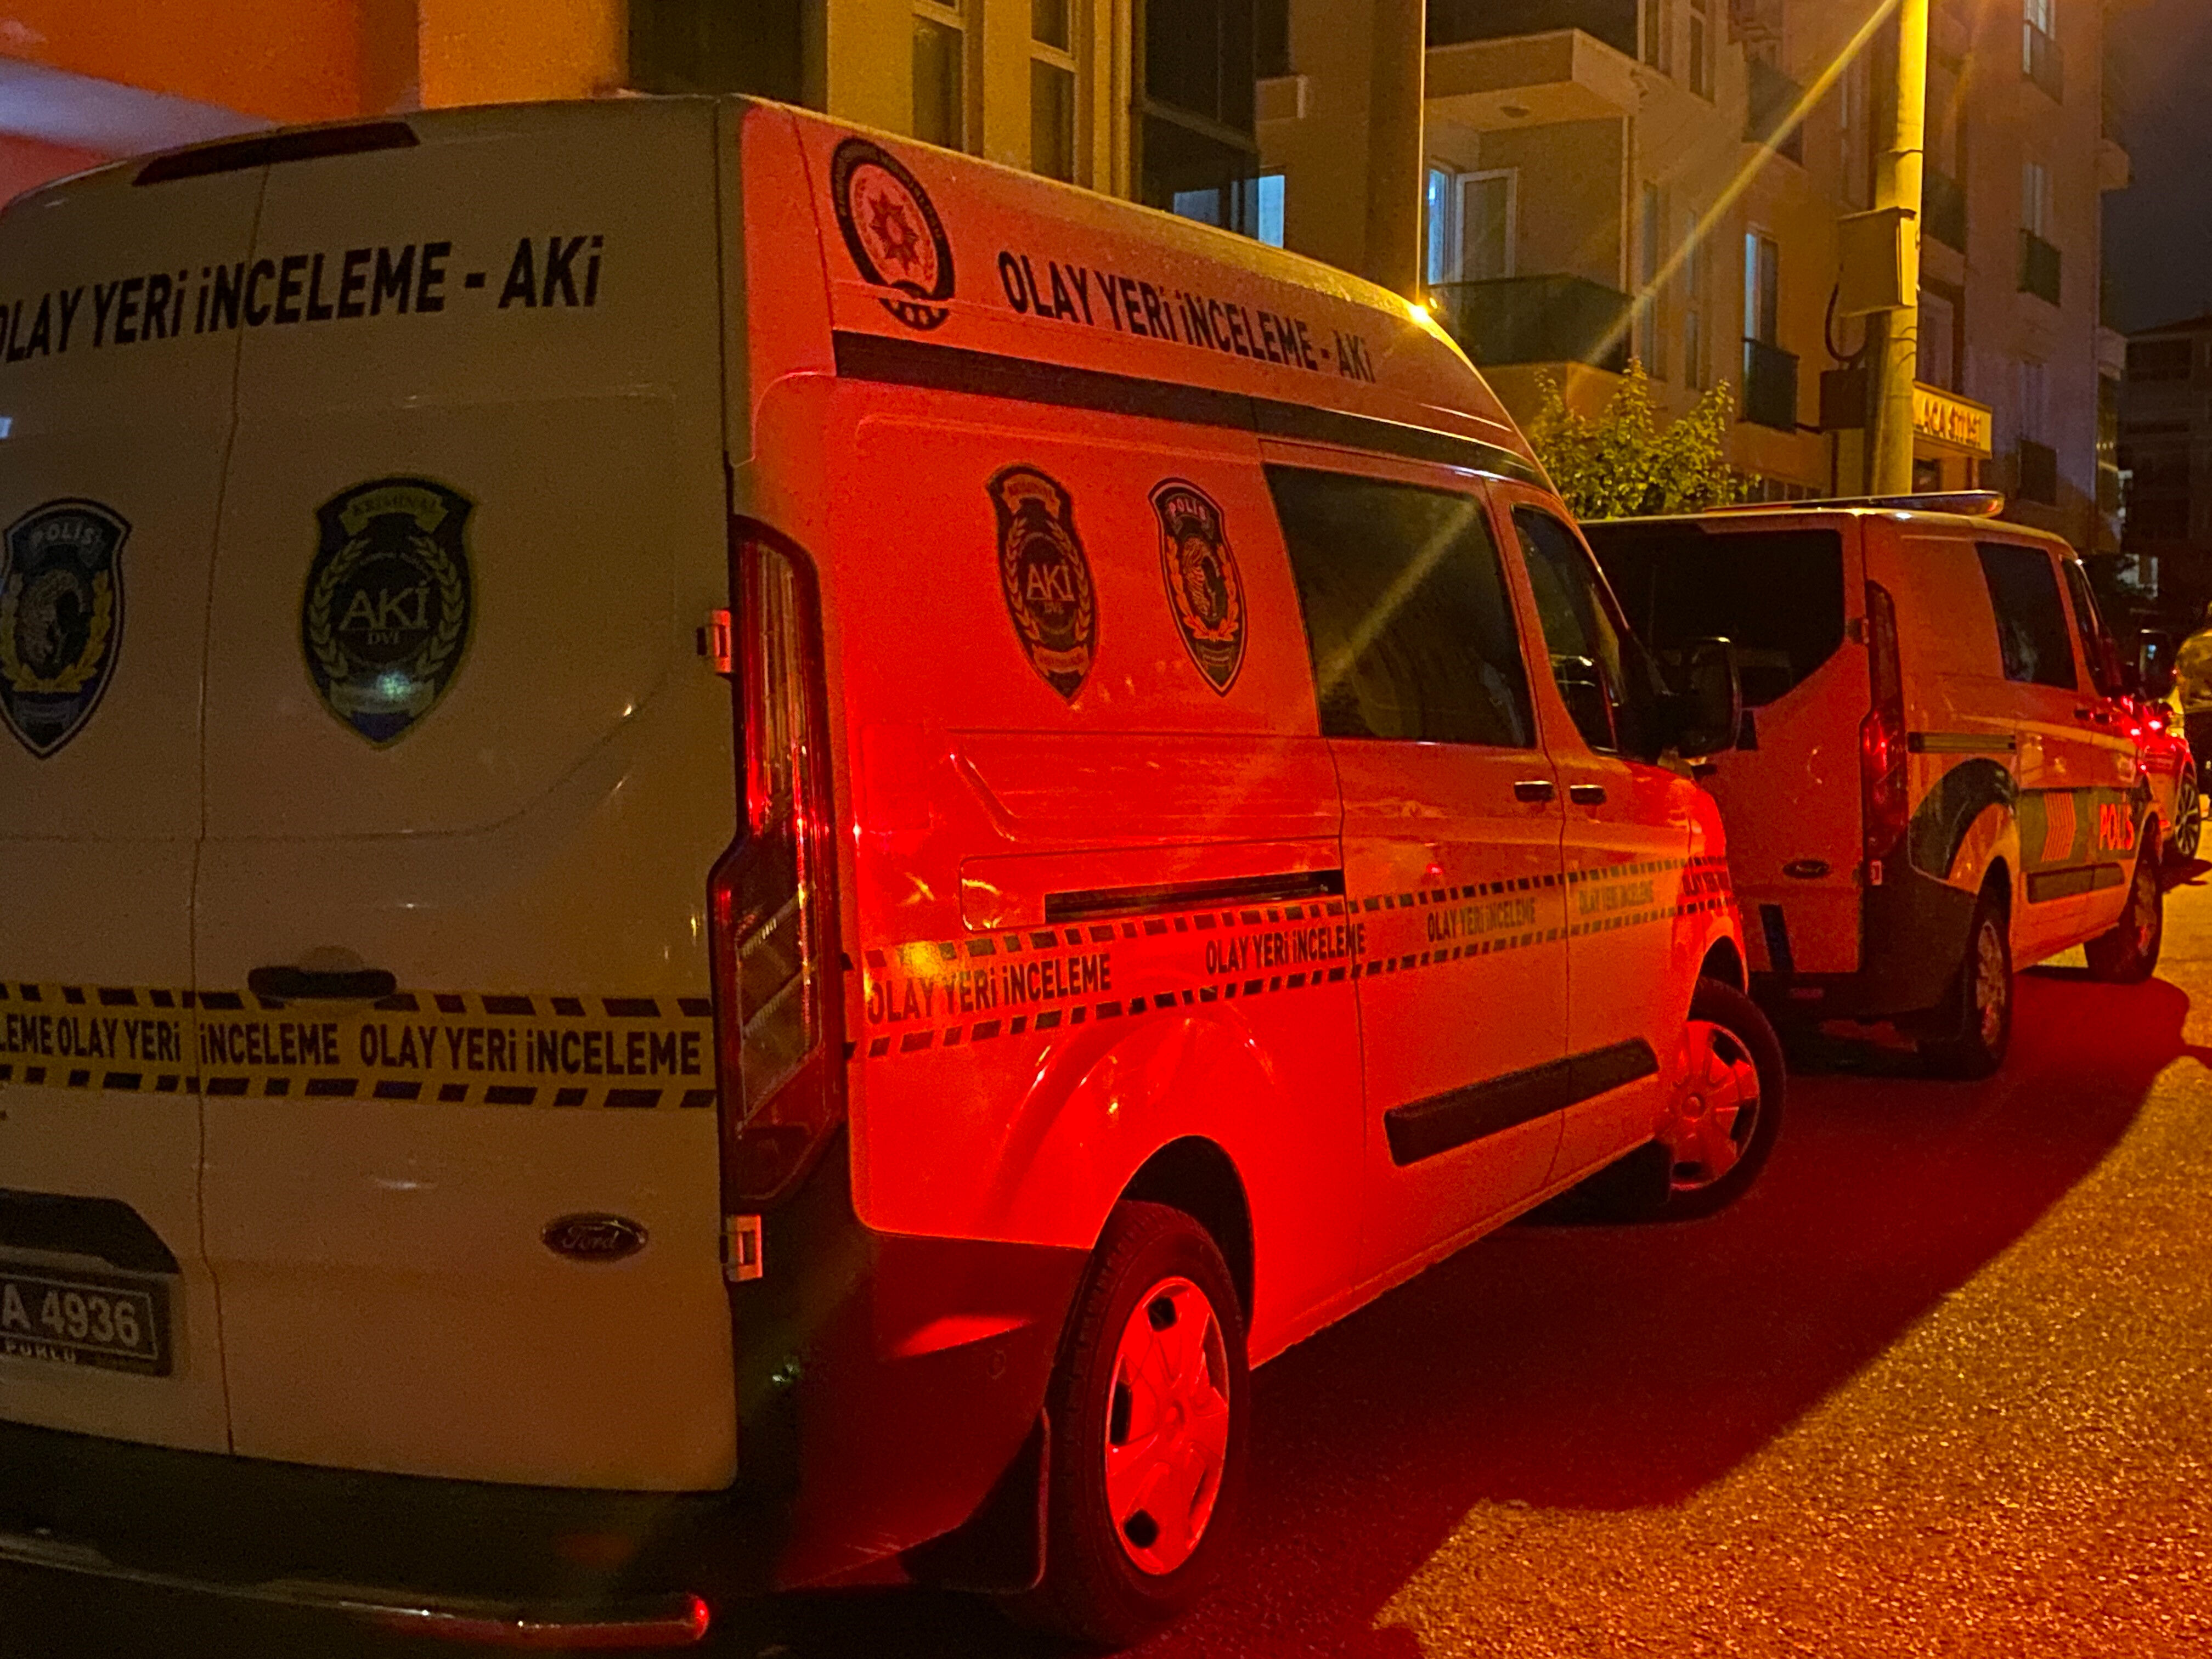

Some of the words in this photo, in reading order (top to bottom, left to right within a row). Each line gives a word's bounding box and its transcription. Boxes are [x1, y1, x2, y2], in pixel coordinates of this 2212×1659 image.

[998, 251, 1094, 326] OLAY
[867, 978, 934, 1025] OLAY
[1205, 936, 1249, 975] OLAY
[0, 1013, 54, 1055] EME
[57, 1016, 117, 1058] OLAY
[360, 1024, 437, 1069] OLAY
[2, 1283, 31, 1329] A
[41, 1290, 140, 1347] 4936
